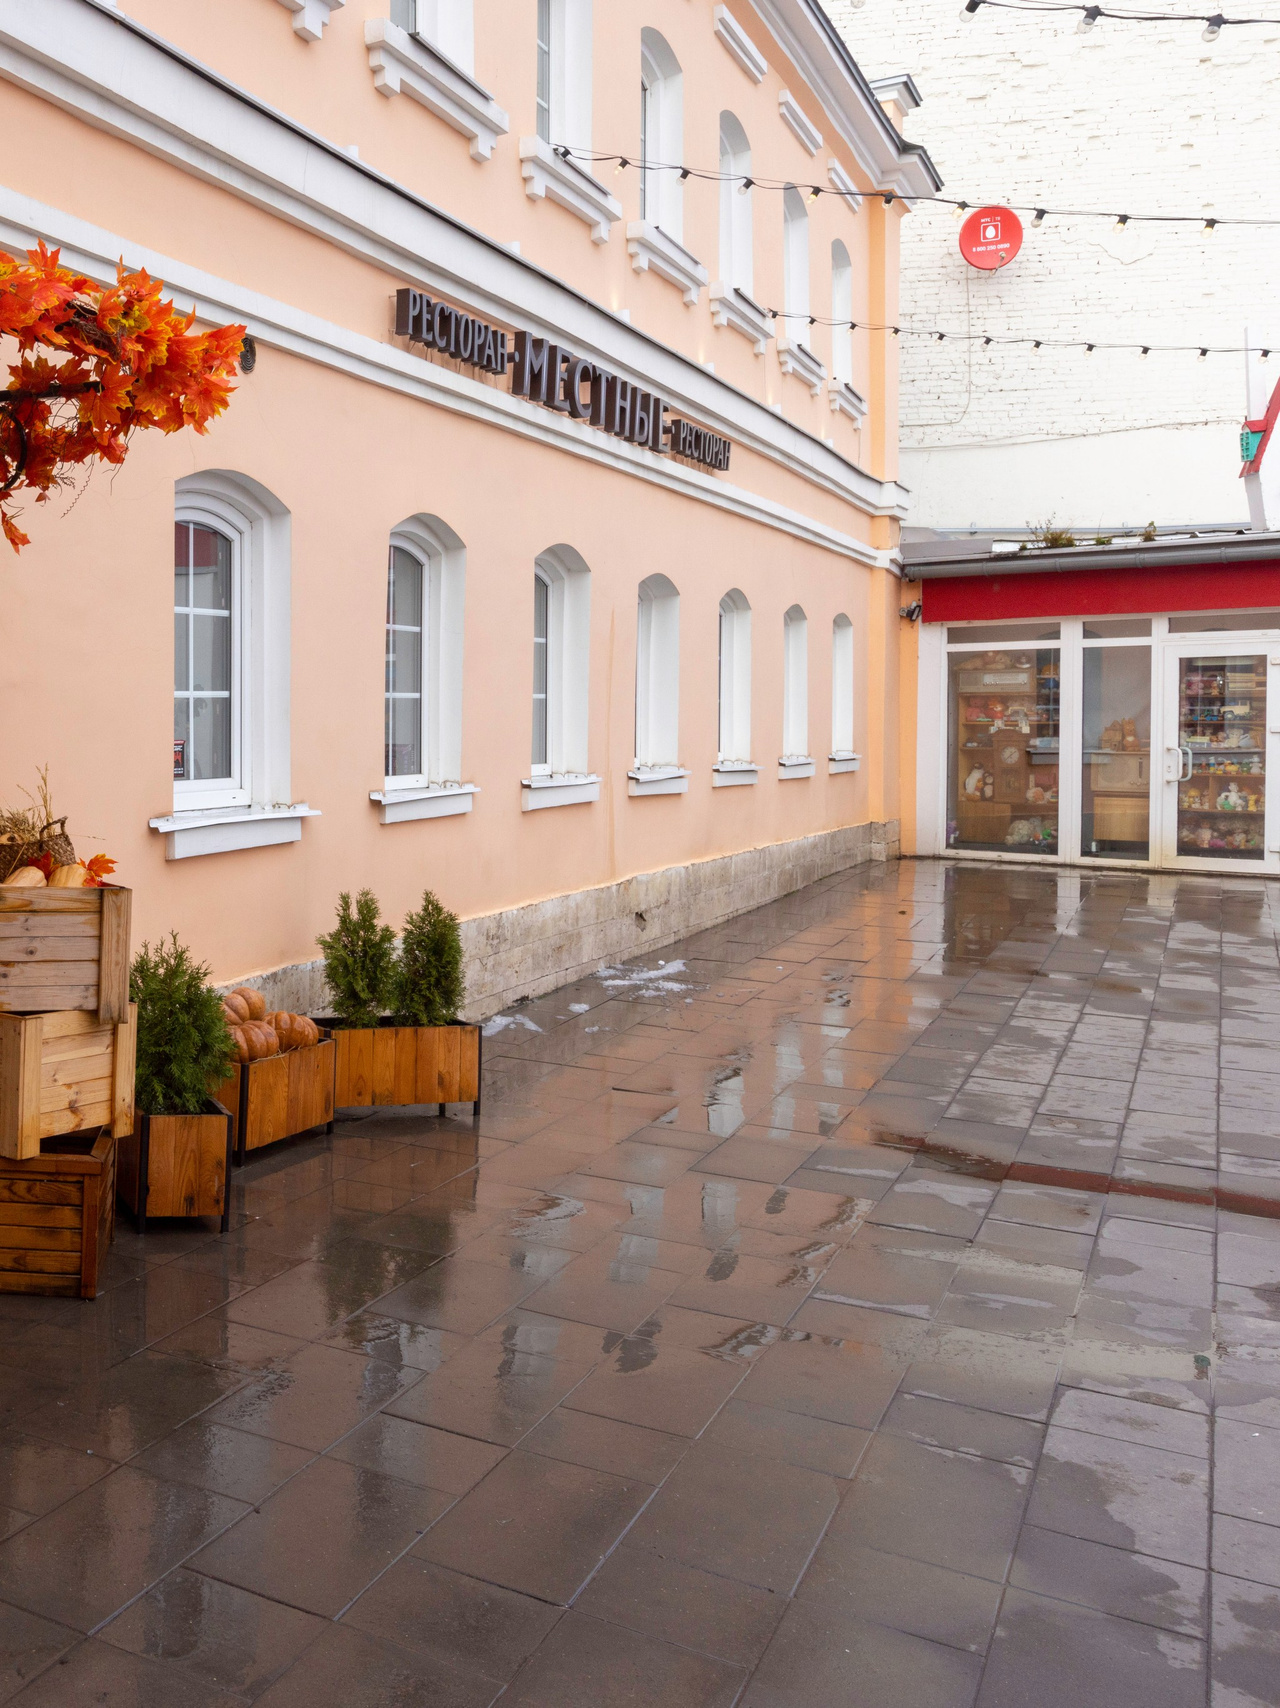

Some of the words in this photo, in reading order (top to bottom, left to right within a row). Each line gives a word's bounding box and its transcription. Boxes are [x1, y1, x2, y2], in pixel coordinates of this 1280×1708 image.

[396, 288, 508, 374] РЕСТОРАН
[512, 331, 671, 453] МЕСТНЫЕ
[671, 419, 731, 471] РЕСТОРАН
